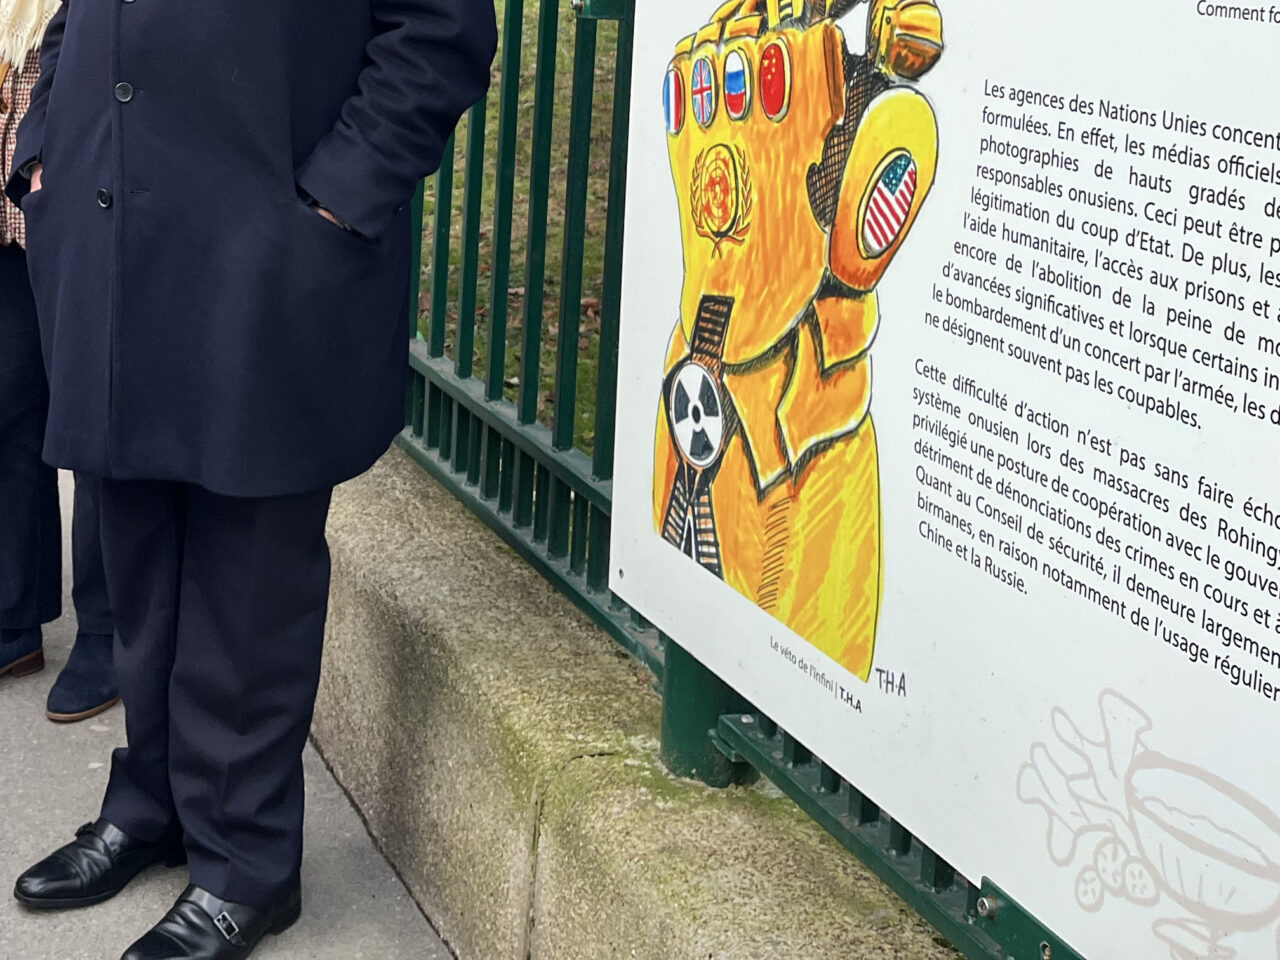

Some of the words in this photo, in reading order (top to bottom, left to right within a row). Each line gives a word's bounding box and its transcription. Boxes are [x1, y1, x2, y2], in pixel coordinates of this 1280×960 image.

[1197, 0, 1265, 22] Comment
[983, 106, 1051, 136] formulées.
[1058, 121, 1074, 142] En
[1081, 127, 1118, 153] effet,
[1125, 134, 1145, 156] les
[1152, 143, 1210, 170] médias
[984, 79, 1005, 98] Les
[1009, 88, 1064, 110] agences
[1069, 94, 1094, 115] des
[1099, 99, 1156, 127] Nations
[1163, 110, 1206, 136] Unies
[977, 165, 1062, 198] responsables
[1068, 188, 1137, 217] onusiens.
[1144, 202, 1177, 226] Ceci
[1184, 216, 1222, 238] peut
[1229, 222, 1262, 248] être
[980, 135, 1078, 172] photographies
[1094, 159, 1113, 180] de
[1129, 166, 1172, 193] hauts
[1189, 185, 1245, 210] gradés
[971, 186, 1049, 224] légitimation
[1056, 210, 1074, 230] du
[1082, 221, 1118, 246] coup
[1126, 228, 1174, 258] d'Etat.
[1182, 242, 1204, 266] De
[1212, 252, 1250, 282] plus,
[943, 261, 1011, 298] d'avancées
[1015, 286, 1104, 330] significatives
[1109, 320, 1124, 338] et
[1129, 321, 1187, 358] lorsque
[1192, 349, 1258, 382] certains
[1264, 367, 1279, 390] in
[954, 242, 996, 265] encore
[1006, 254, 1022, 274] de
[1032, 260, 1101, 299] l'abolition
[1112, 286, 1131, 308] de
[1143, 294, 1154, 316] la
[1166, 307, 1212, 334] peine
[1224, 321, 1245, 345] de
[925, 312, 939, 328] ne
[942, 316, 1004, 353] désignent
[1008, 344, 1062, 376] souvent
[1066, 365, 1090, 386] pas
[1094, 370, 1113, 395] les
[1118, 386, 1201, 429] coupables.
[933, 283, 942, 302] le
[946, 288, 1046, 340] bombardement
[1050, 326, 1080, 352] d'un
[1084, 343, 1141, 374] concert
[1144, 364, 1170, 384] par
[1174, 368, 1238, 413] l'armée,
[1243, 392, 1266, 420] les
[913, 388, 961, 418] système
[968, 412, 1018, 445] onusien
[1028, 432, 1051, 459] lors
[1060, 449, 1084, 474] des
[1094, 467, 1169, 512] massacres
[1180, 503, 1207, 530] des
[915, 359, 946, 385] Cette
[953, 374, 1007, 411] difficulté
[1015, 400, 1068, 438] d'action
[1078, 429, 1112, 456] n'est
[1120, 448, 1146, 470] pas
[1154, 463, 1188, 489] sans
[1198, 476, 1234, 508] faire
[916, 465, 952, 497] Quant
[956, 489, 971, 507] au
[976, 496, 1022, 533] Conseil
[1027, 522, 1044, 544] de
[1049, 536, 1107, 580] sécurité,
[1113, 564, 1121, 584] il
[1126, 574, 1195, 623] demeure
[1202, 609, 1280, 669] largemen
[918, 491, 975, 539] birmanes,
[979, 530, 994, 548] en
[999, 539, 1038, 571] raison
[1043, 563, 1126, 619] notamment
[1130, 608, 1149, 631] de
[1154, 617, 1208, 664] l'usage
[1214, 655, 1280, 701] régulier
[919, 521, 952, 552] Chine
[956, 545, 968, 561] et
[971, 547, 980, 568] la
[985, 556, 1027, 594] Russie.
[770, 636, 779, 648] Le
[780, 646, 797, 665] véto
[798, 657, 808, 673] de
[810, 664, 833, 692] l'infini
[839, 686, 862, 714] T.H.A
